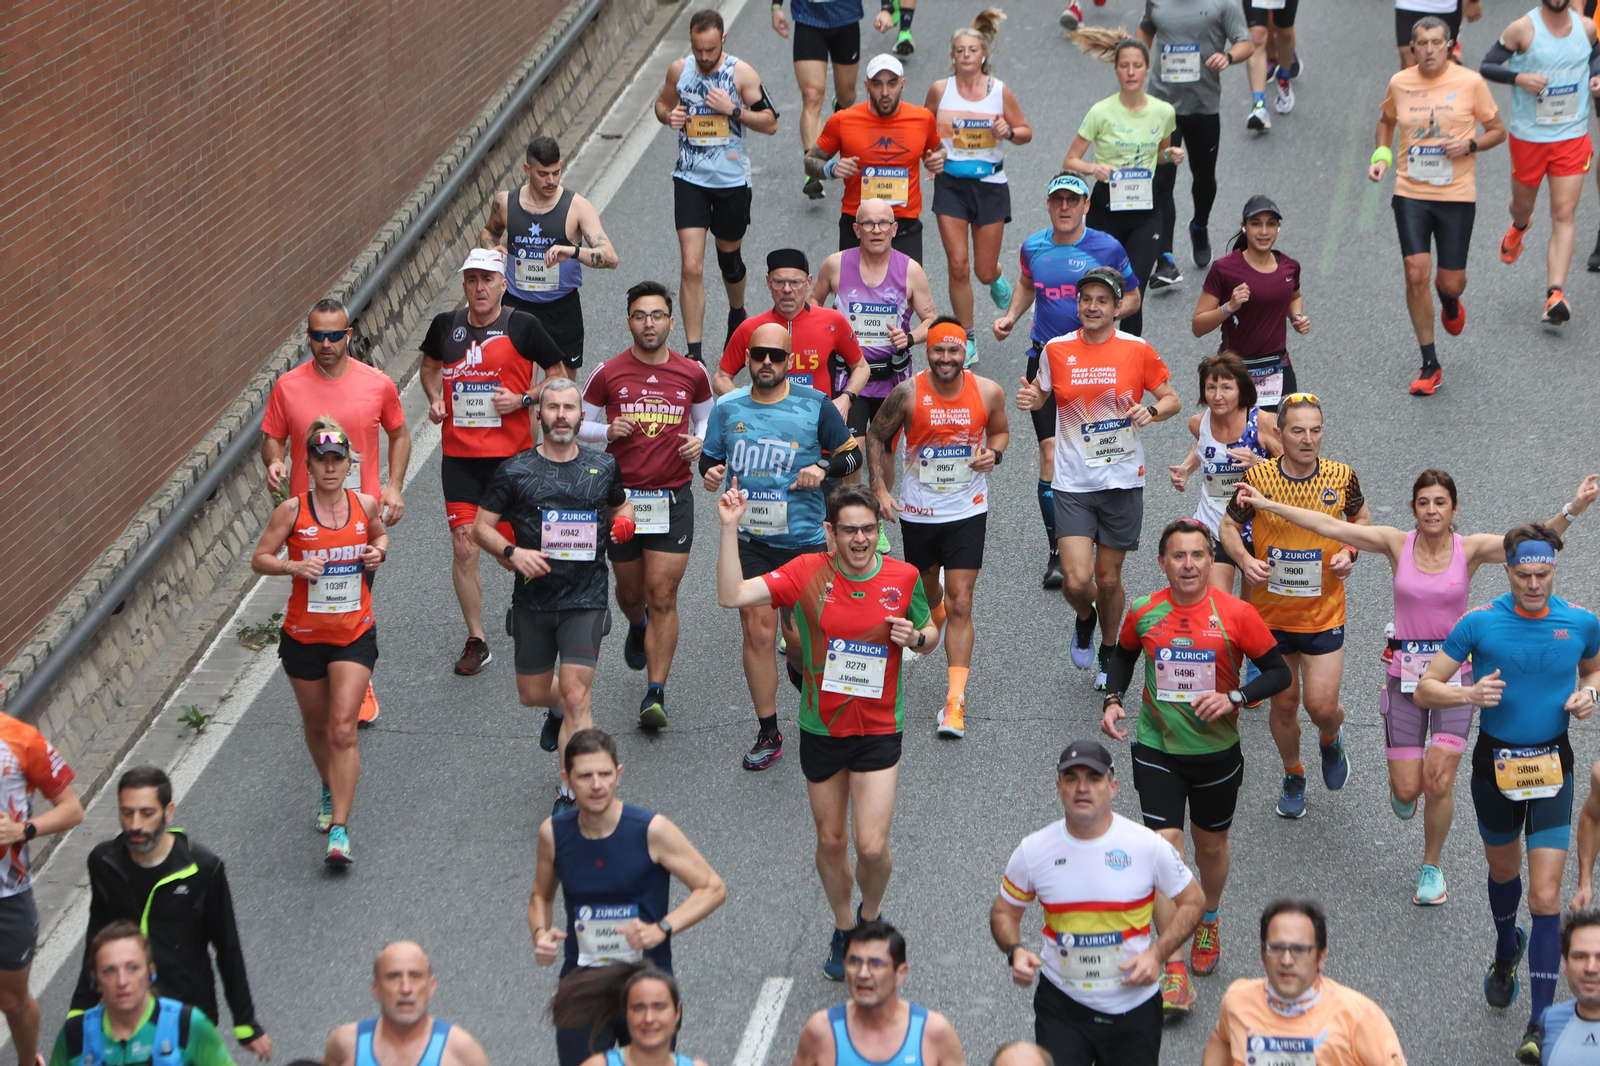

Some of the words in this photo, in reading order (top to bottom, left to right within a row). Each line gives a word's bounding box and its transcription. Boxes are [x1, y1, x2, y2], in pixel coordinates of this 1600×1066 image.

[1551, 86, 1574, 96] ZURICH
[966, 120, 992, 128] ZURICH
[878, 169, 904, 177] ZURICH
[1123, 171, 1149, 179] ZURICH
[514, 236, 557, 245] SAYSKY
[528, 251, 544, 260] ZURI
[1068, 258, 1085, 268] Krys
[527, 265, 544, 273] 8534
[525, 275, 546, 283] FRANKIE
[864, 304, 893, 313] ZURICH
[863, 319, 881, 327] 9203
[854, 330, 879, 338] Marathon
[787, 376, 808, 384] RICH
[1070, 377, 1117, 386] MARATHON
[466, 398, 484, 407] 9278
[930, 418, 972, 427] MARATHON
[1099, 436, 1118, 446] 8922
[936, 448, 966, 457] ZURICH
[936, 464, 955, 472] 8957
[936, 475, 956, 484] Espino
[751, 490, 781, 500] ZURICH
[633, 504, 652, 512] 8539
[750, 506, 769, 515] 8951
[904, 503, 935, 516] NOV21
[561, 512, 593, 521] ZURICH
[560, 529, 580, 537] 6942
[545, 541, 572, 549] JAVICHU
[1284, 550, 1317, 560] ZURICH
[327, 564, 358, 574] ZURICH
[1283, 566, 1304, 576] 9900
[324, 581, 348, 591] 10397
[1279, 578, 1310, 586] SANDRINO
[325, 594, 347, 603] Montse
[848, 643, 882, 656] ZURICH
[1422, 643, 1441, 653] ZUR
[1174, 650, 1208, 661] ZURICH
[845, 660, 867, 672] 8279
[1173, 668, 1195, 678] 6496
[838, 674, 871, 686] J.Valiente
[1177, 682, 1193, 691] ZULI
[1517, 764, 1540, 775] 5888
[1516, 778, 1545, 789] CARLOS
[594, 905, 631, 918] ZURICH
[1078, 933, 1116, 946] ZURICH
[1084, 970, 1101, 979] JAVI
[1269, 1039, 1306, 1052] ZURICH
